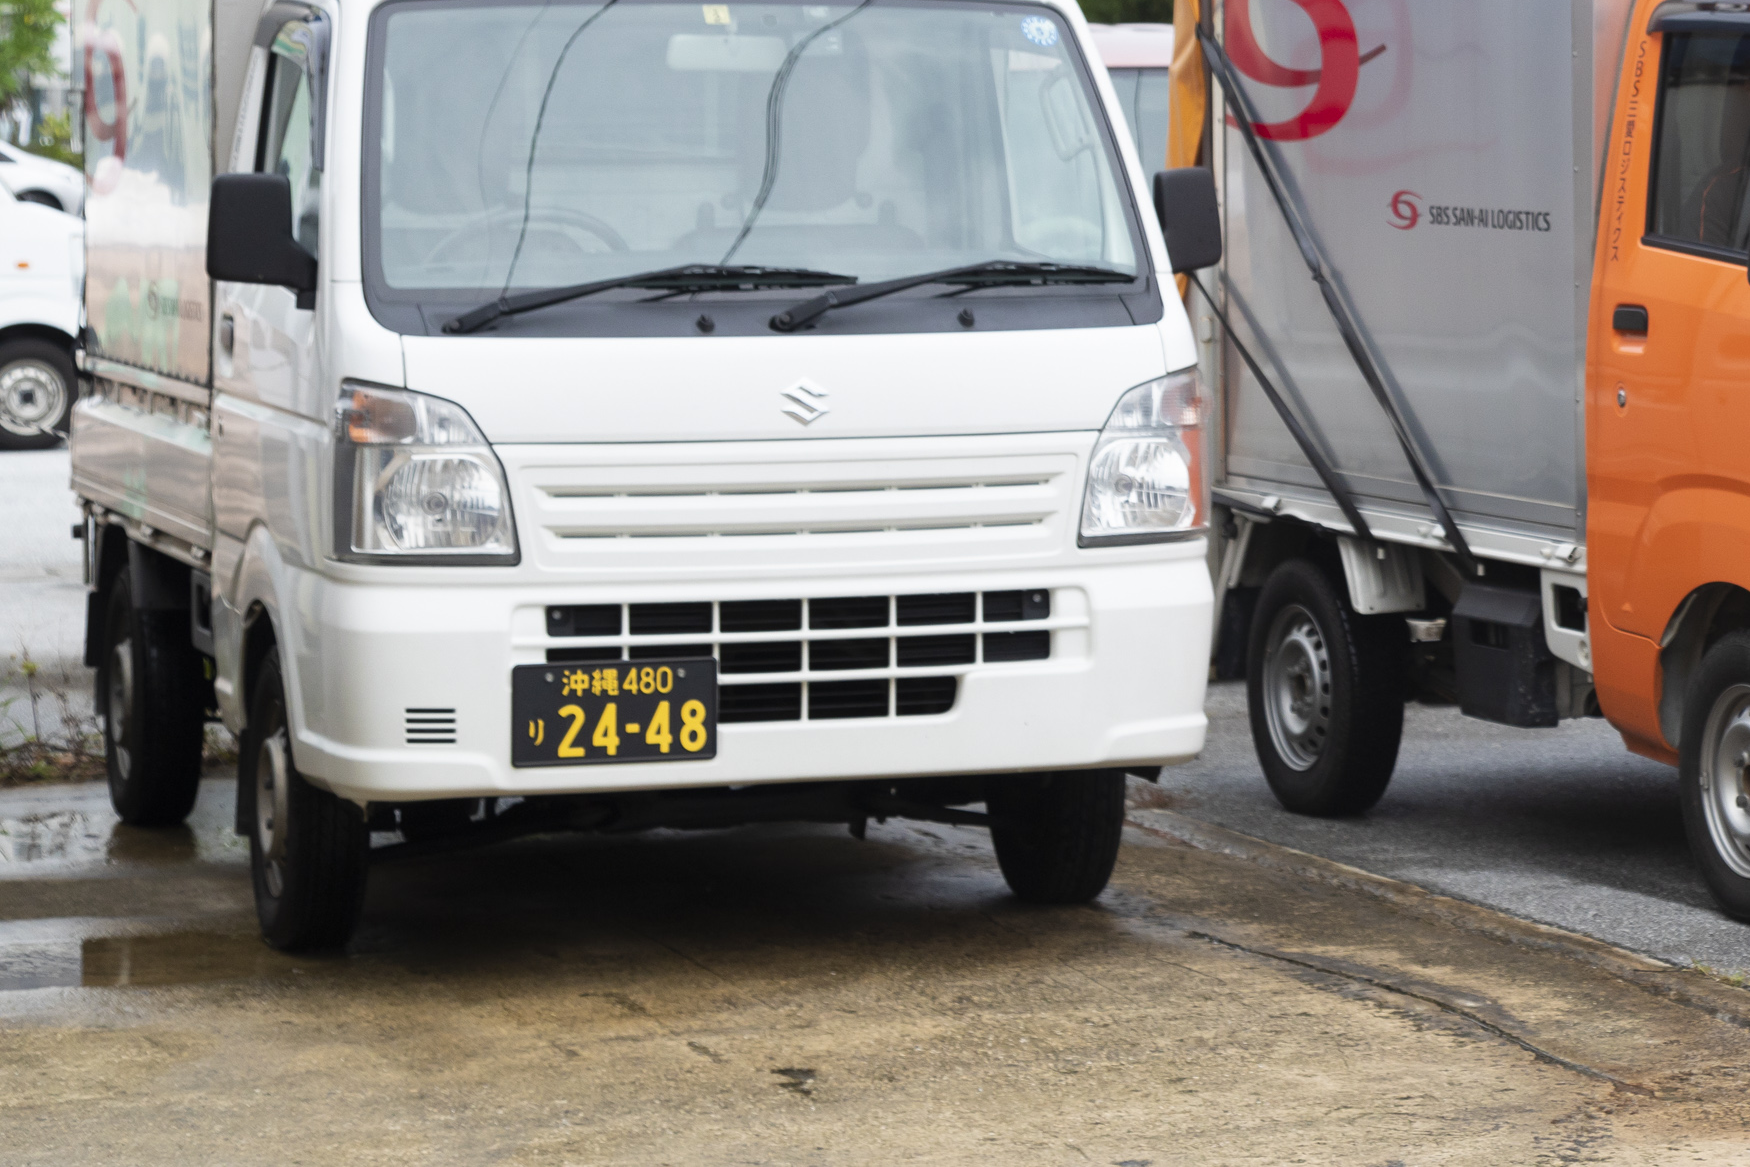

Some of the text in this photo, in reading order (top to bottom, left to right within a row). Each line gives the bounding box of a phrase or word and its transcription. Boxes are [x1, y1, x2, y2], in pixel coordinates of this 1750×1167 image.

[1428, 205, 1551, 233] SBS SAN-AI LOGISTICS
[528, 699, 708, 759] り 24-48
